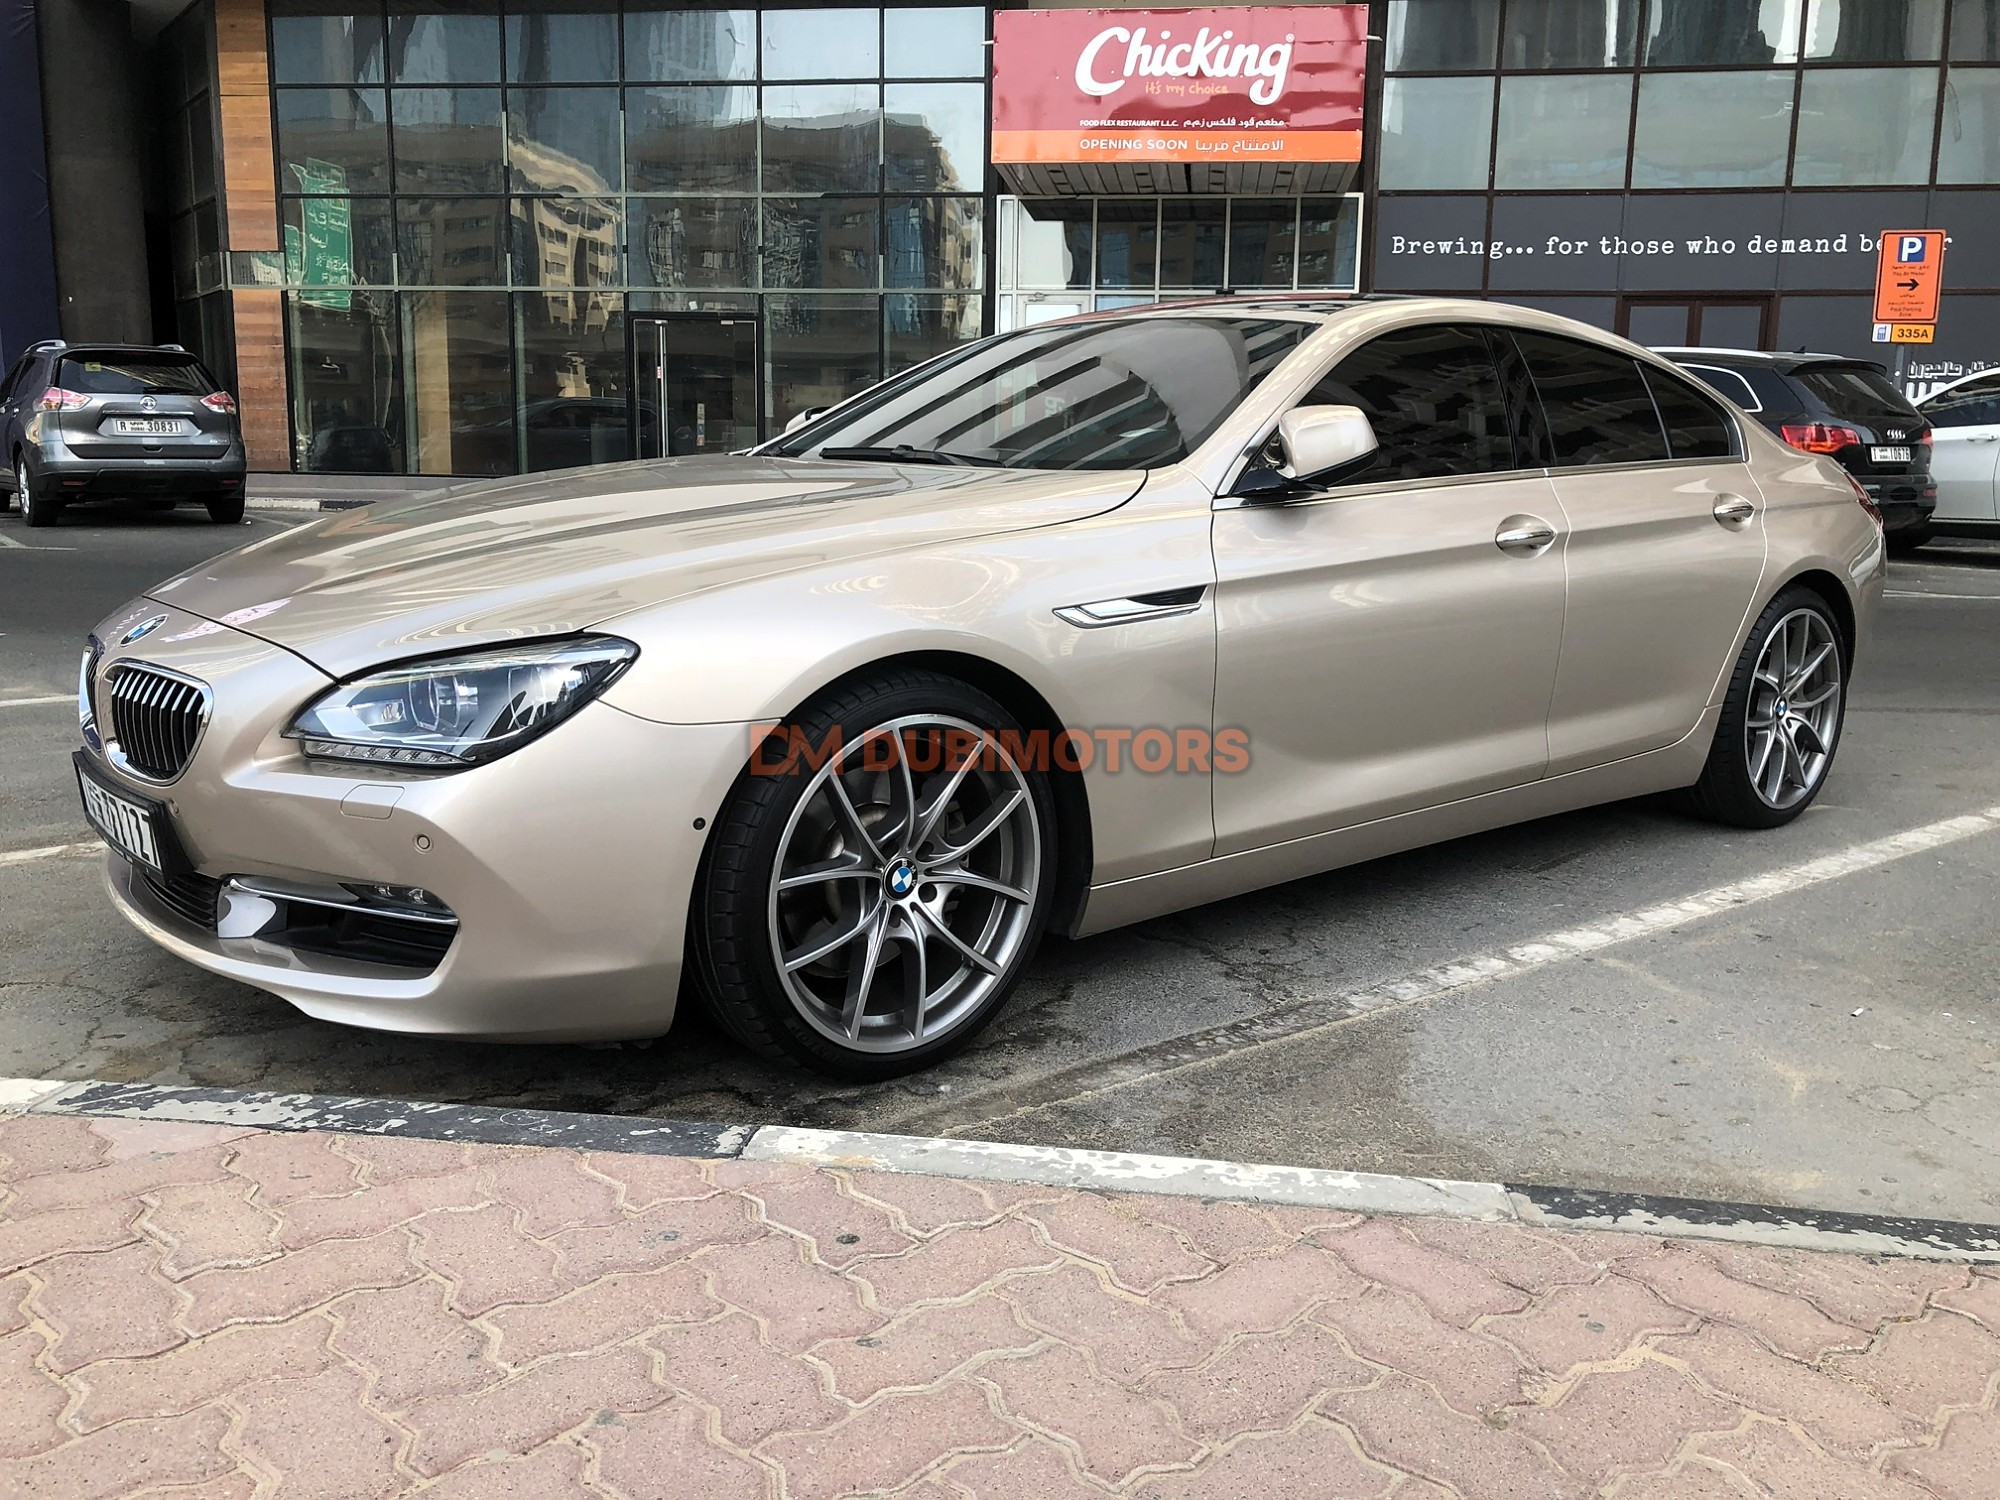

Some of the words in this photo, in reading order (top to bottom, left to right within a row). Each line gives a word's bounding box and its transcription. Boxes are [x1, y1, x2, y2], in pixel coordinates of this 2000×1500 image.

[1166, 84, 1185, 96] my
[1188, 81, 1229, 95] choice
[1080, 119, 1099, 127] FOOD
[1100, 119, 1116, 127] FLEX
[1116, 119, 1160, 127] RESTAURANT
[1206, 117, 1236, 129] فلكس
[1255, 117, 1285, 128] مطعم
[1080, 139, 1142, 150] OPENING
[1147, 139, 1188, 150] SOON
[1194, 137, 1229, 153] قريبا
[1391, 236, 1534, 260] Brewing...
[1544, 236, 1589, 255] for
[1598, 236, 1675, 255] those
[1686, 235, 1736, 254] who
[1747, 234, 1848, 254] demand
[1901, 237, 1923, 262] P
[1897, 328, 1929, 339] 335A
[119, 420, 127, 432] R
[147, 420, 179, 432] 30831
